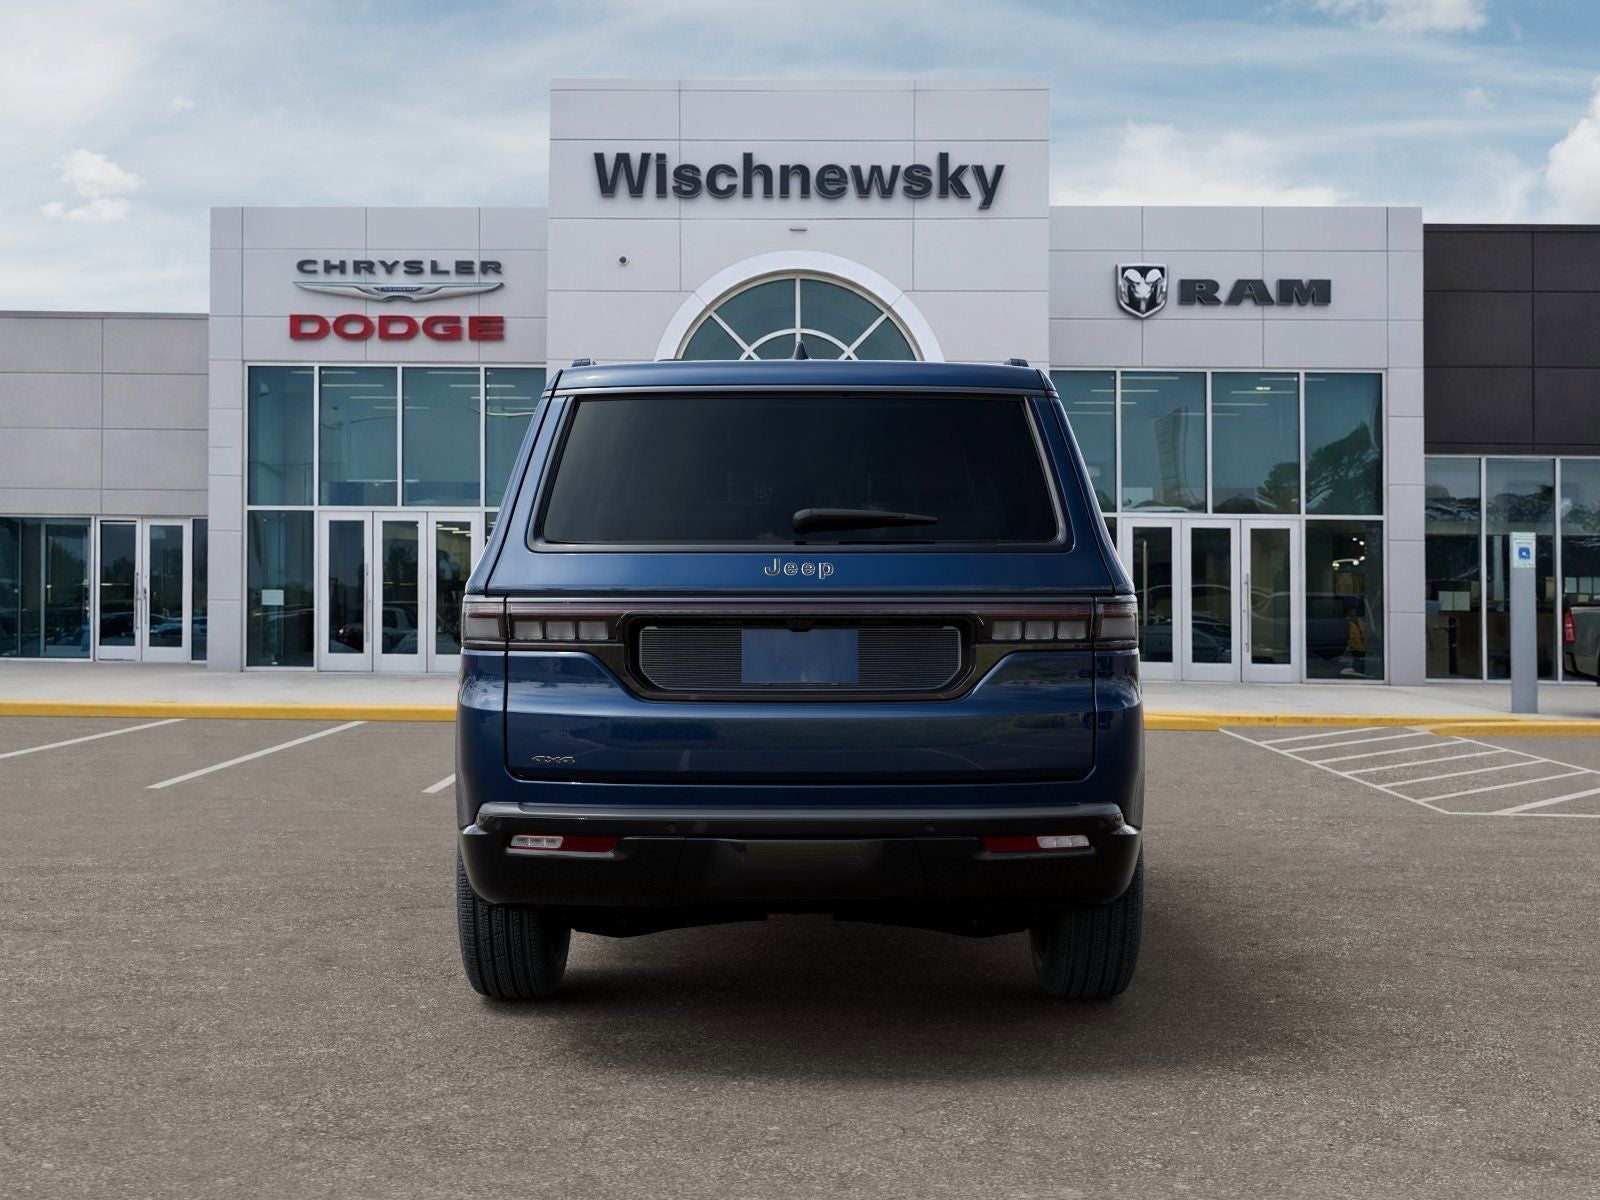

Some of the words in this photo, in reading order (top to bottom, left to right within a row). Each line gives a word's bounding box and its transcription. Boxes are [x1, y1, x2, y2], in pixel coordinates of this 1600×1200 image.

[593, 152, 1005, 210] Wischnewsky
[297, 259, 503, 275] CHRYSLER
[1177, 279, 1332, 306] RAM
[289, 314, 504, 341] DODGE
[764, 558, 834, 579] Jeep
